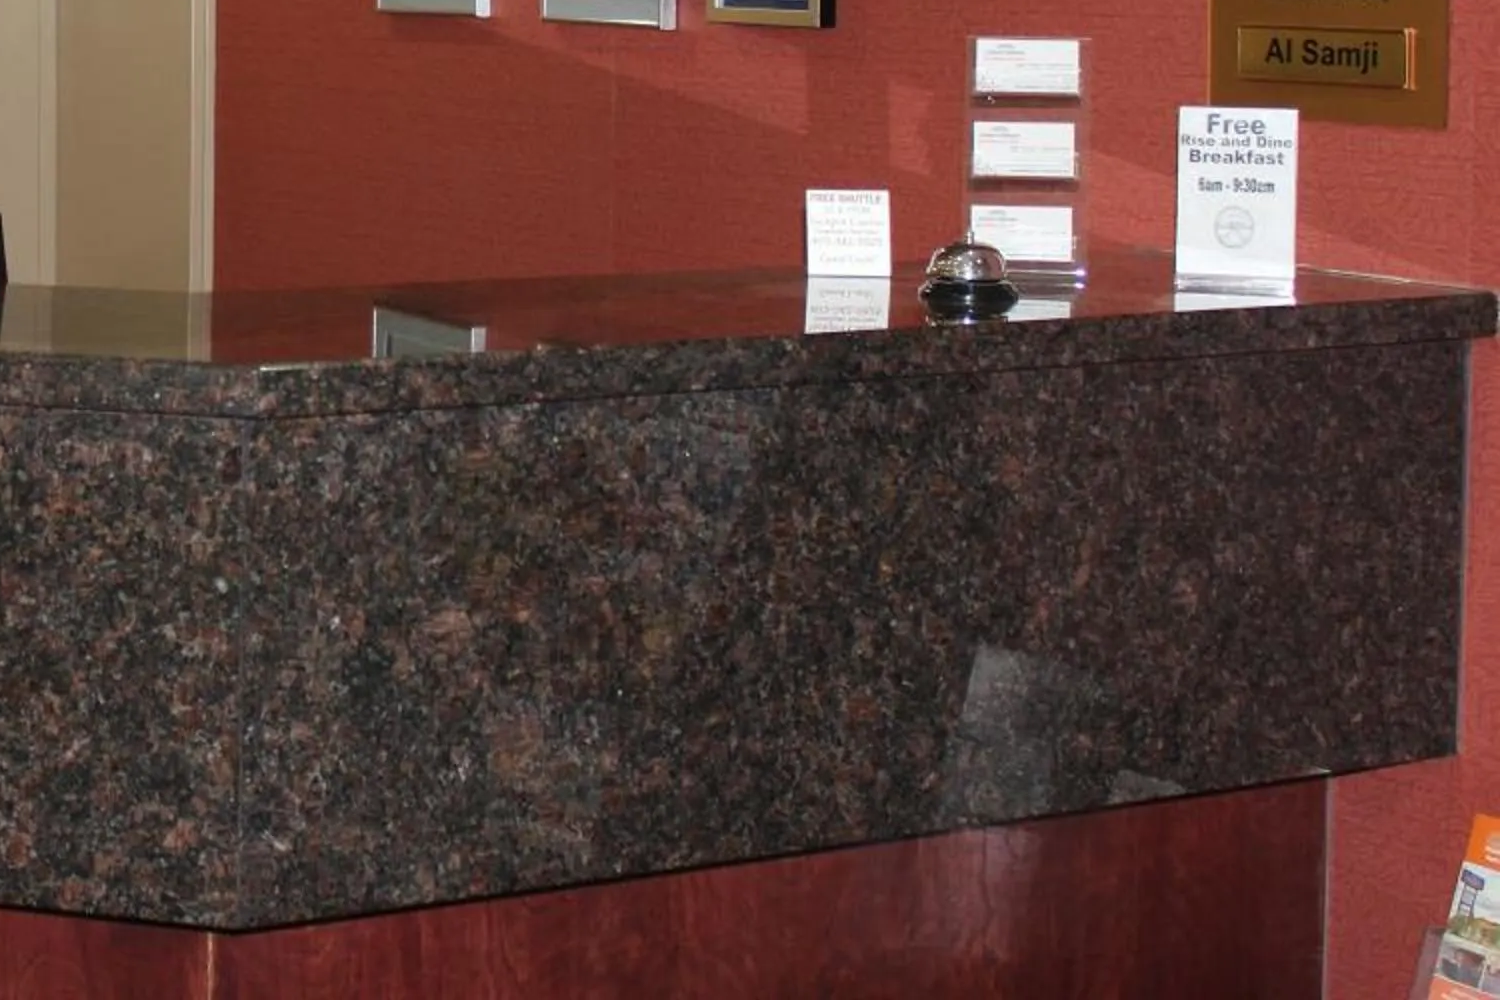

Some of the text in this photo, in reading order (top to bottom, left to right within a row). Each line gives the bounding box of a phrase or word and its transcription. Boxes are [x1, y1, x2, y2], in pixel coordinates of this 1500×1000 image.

[1265, 37, 1379, 75] Al Samji
[1206, 112, 1267, 135] Free
[1180, 133, 1216, 147] Rise
[1220, 135, 1251, 147] and
[1189, 148, 1285, 166] Breakfast
